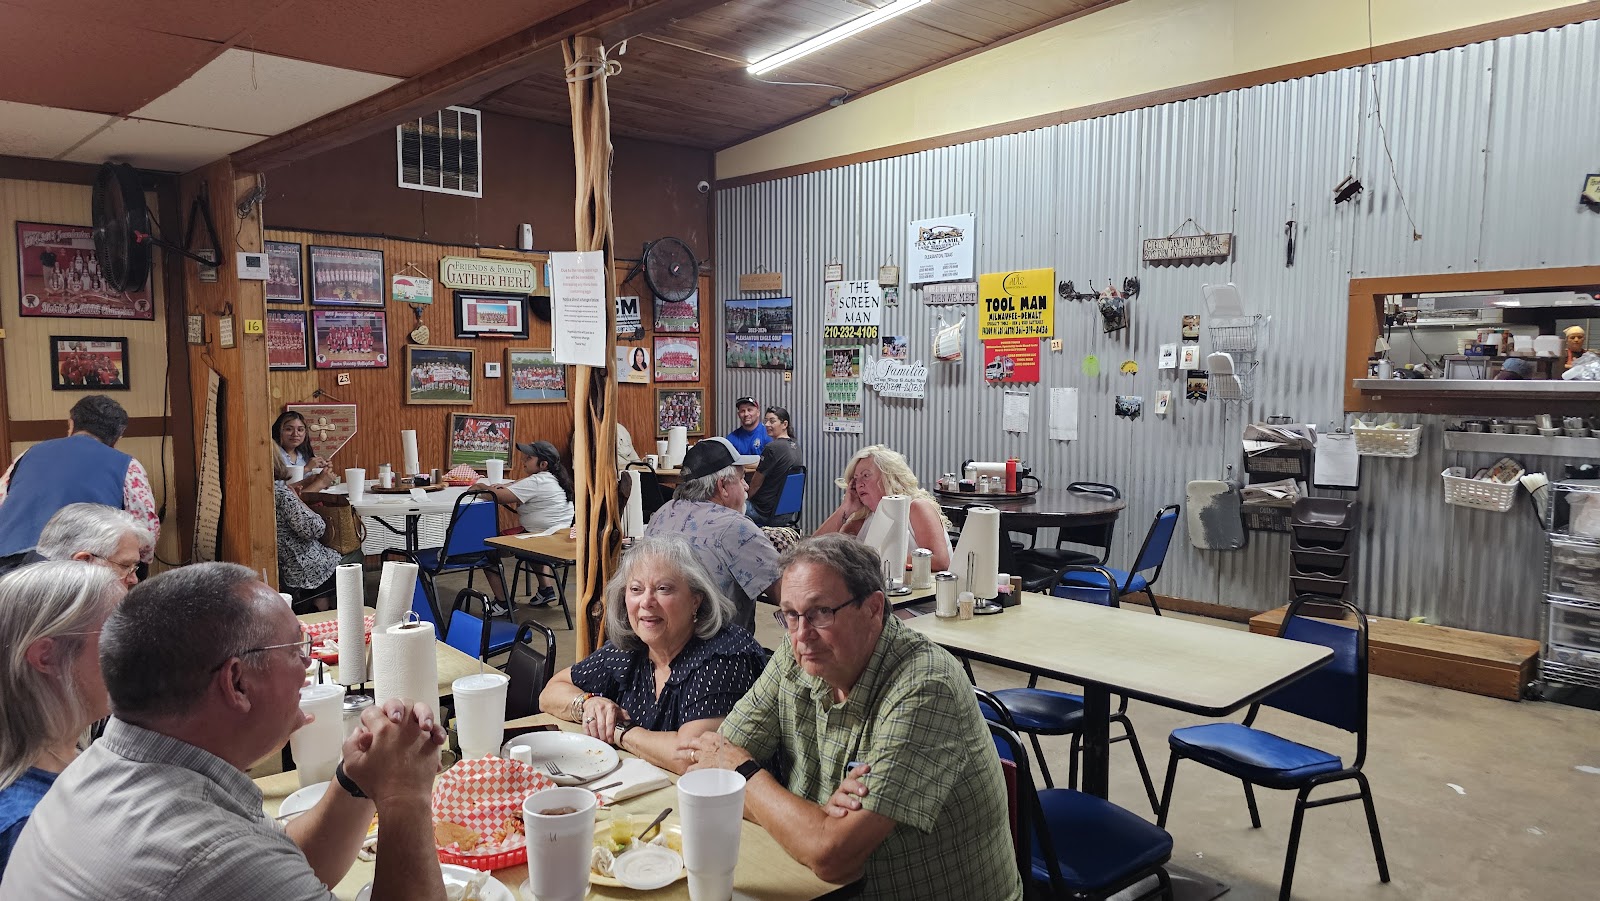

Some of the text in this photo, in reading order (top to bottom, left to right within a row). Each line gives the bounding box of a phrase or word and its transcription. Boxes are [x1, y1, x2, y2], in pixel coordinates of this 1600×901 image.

[938, 236, 965, 245] FAMILY
[1147, 240, 1164, 250] GIRLS
[1182, 238, 1198, 248] INTO
[455, 261, 488, 272] FRIENDS
[498, 264, 524, 274] FAMILY
[447, 264, 531, 288] GATHER HERE
[850, 282, 869, 293] THE
[839, 296, 879, 309] SCREEN
[931, 293, 945, 302] THEN
[947, 293, 957, 302] WE
[959, 292, 975, 302] MET
[986, 296, 1046, 312] TOOL MAN
[845, 312, 871, 323] MAN
[248, 322, 260, 331] 16
[824, 326, 877, 338] 210-232-4106
[876, 360, 925, 378] Familia
[339, 374, 349, 382] 23
